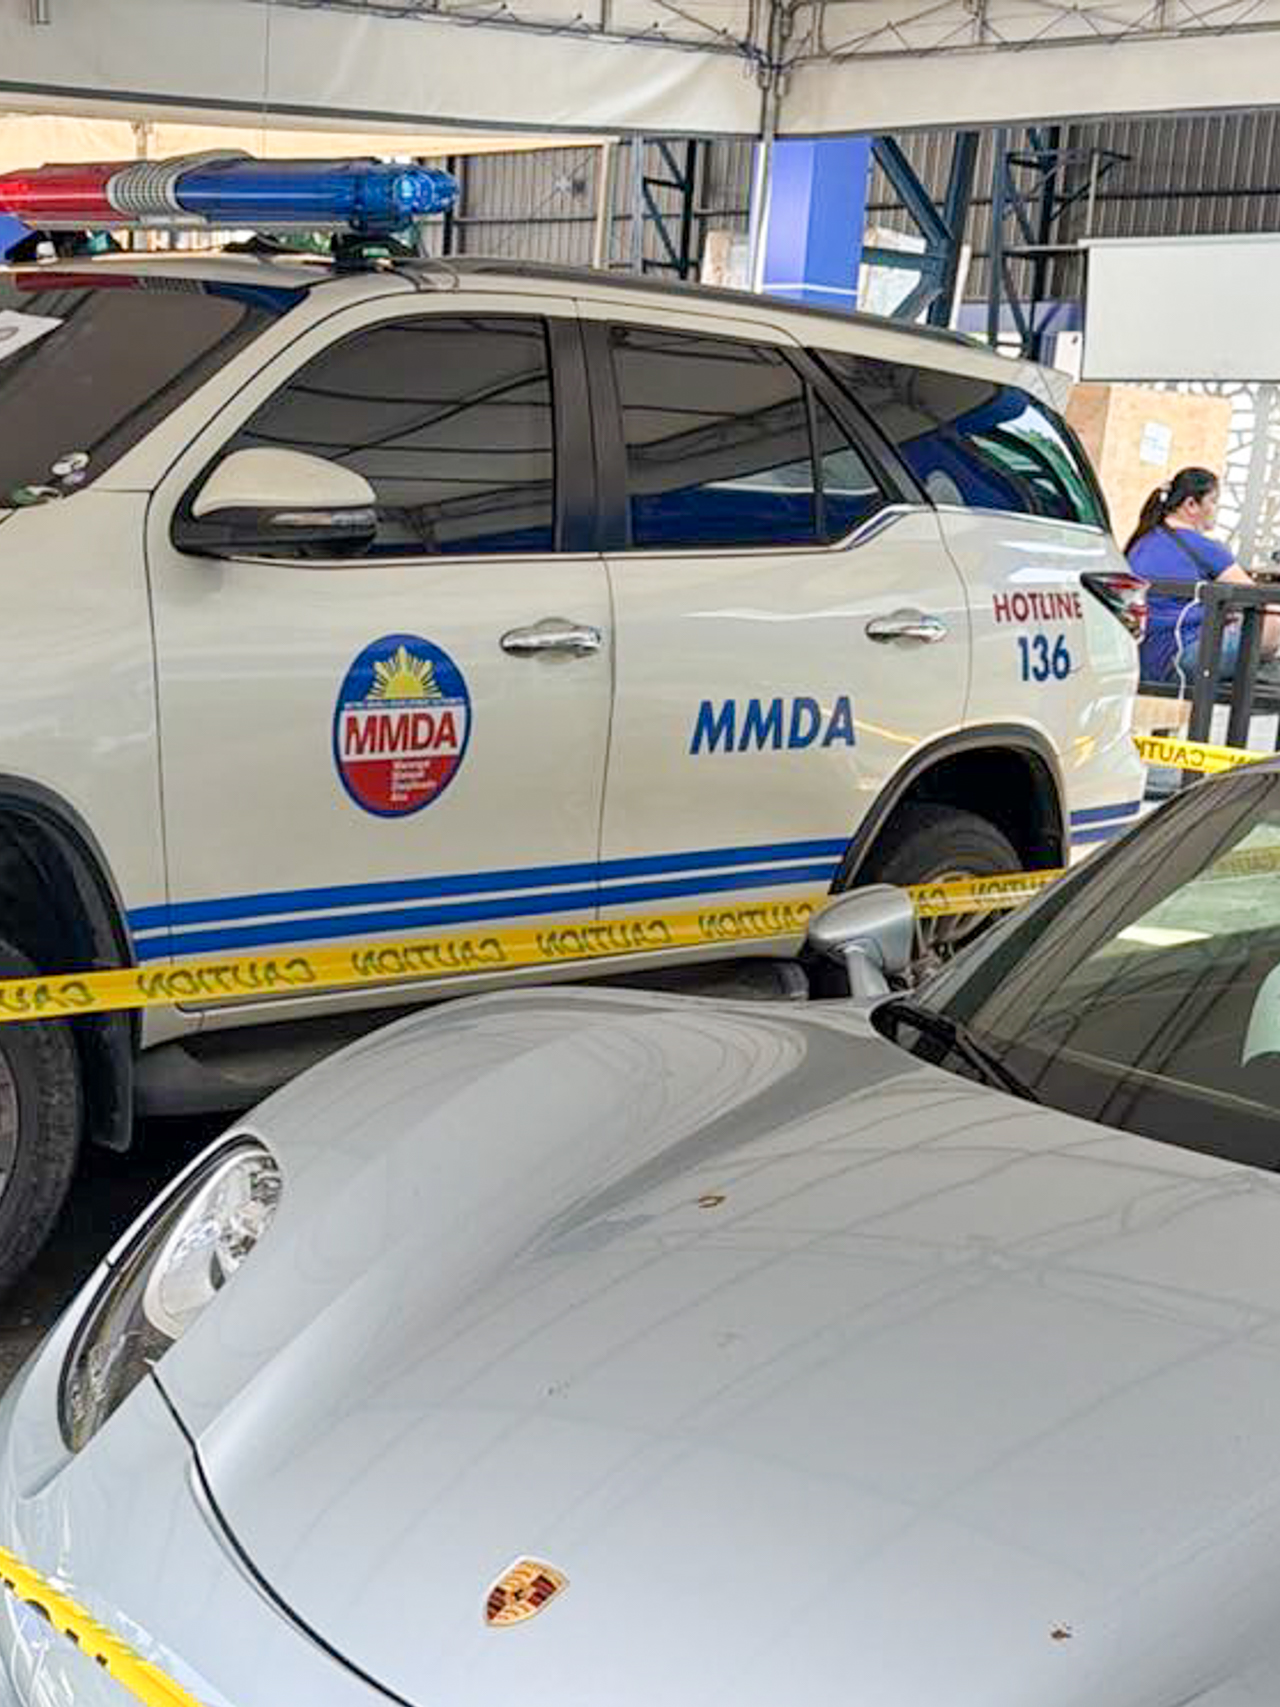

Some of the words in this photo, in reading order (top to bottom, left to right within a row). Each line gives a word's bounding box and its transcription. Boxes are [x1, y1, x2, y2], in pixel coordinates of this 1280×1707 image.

[993, 592, 1083, 622] HOTLINE
[1019, 634, 1072, 682] 136
[344, 711, 458, 755] MMDA
[690, 696, 856, 755] MMDA
